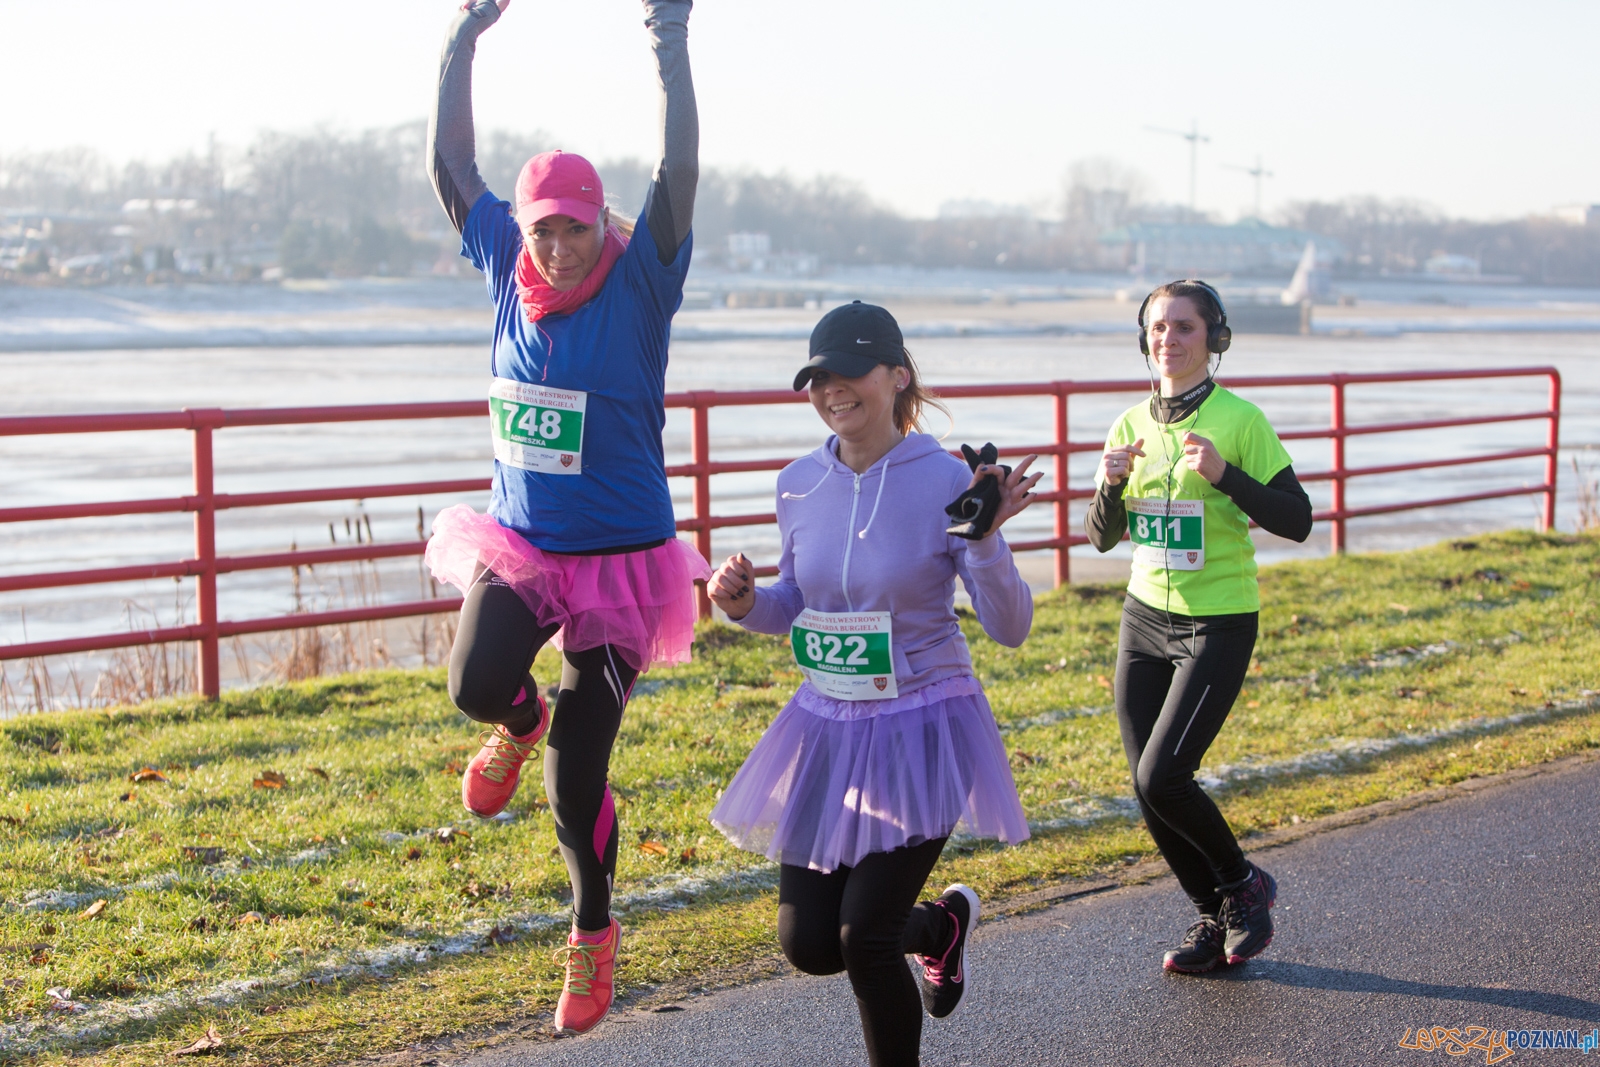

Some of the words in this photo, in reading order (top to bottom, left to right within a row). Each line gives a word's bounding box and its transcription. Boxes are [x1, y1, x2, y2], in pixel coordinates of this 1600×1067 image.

[527, 388, 578, 401] SYLWESTROWY
[540, 399, 574, 409] BURGIELA
[502, 402, 561, 440] 748
[510, 434, 546, 446] AGNIESZKA
[1136, 515, 1182, 542] 811
[825, 616, 882, 624] SYLWESTROWY
[840, 624, 879, 632] BURGIELA
[805, 632, 869, 665] 822
[816, 662, 858, 674] MAGDALENA
